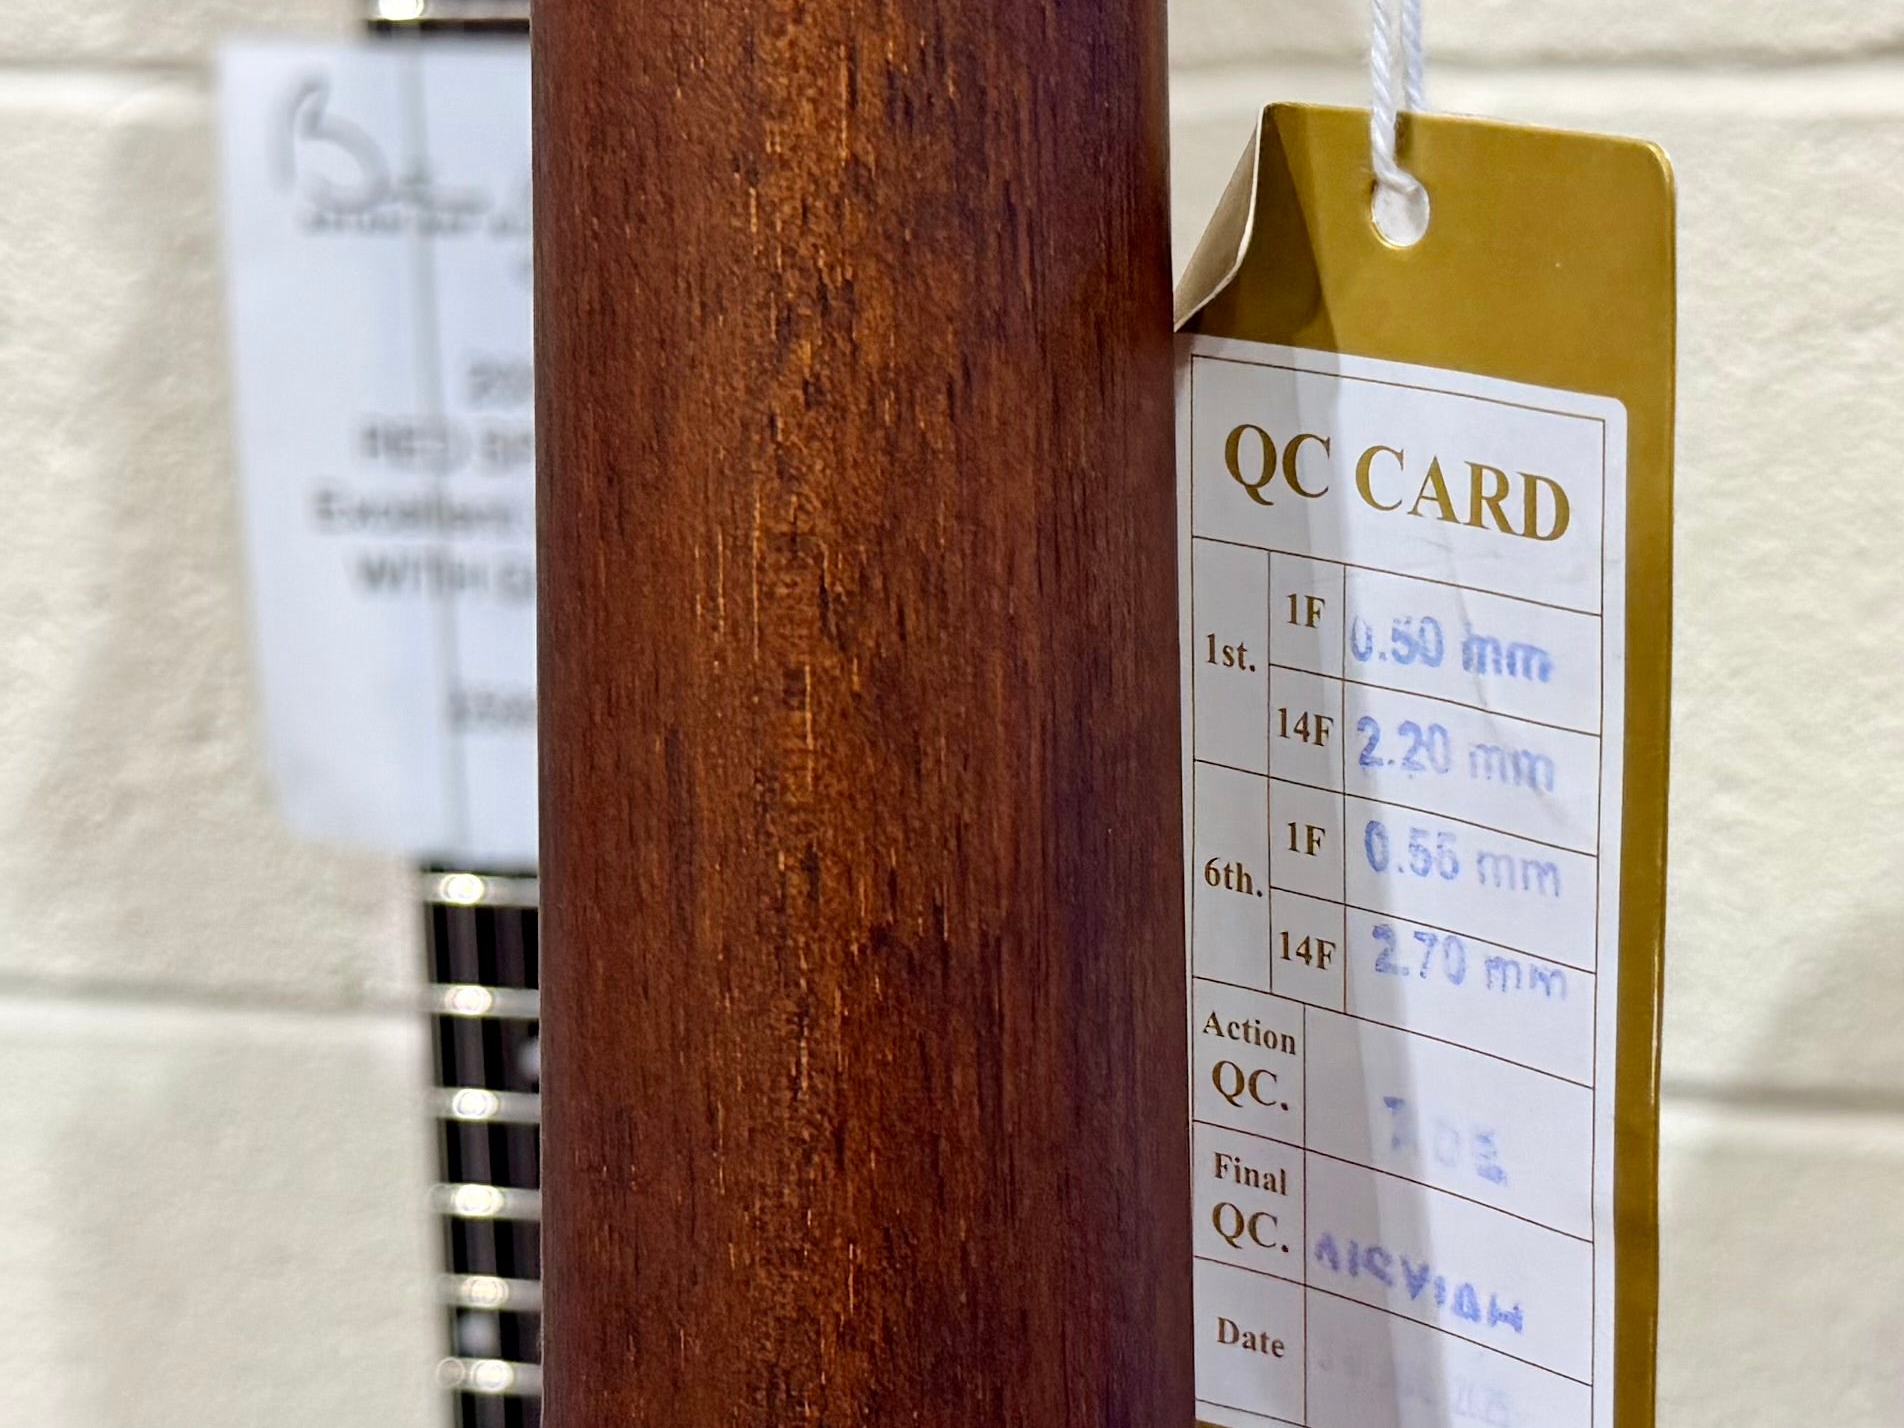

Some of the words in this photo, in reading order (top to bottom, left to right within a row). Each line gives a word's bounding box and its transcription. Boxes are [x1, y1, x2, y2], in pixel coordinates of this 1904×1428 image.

[1224, 423, 1331, 507] QC
[1354, 444, 1571, 542] CARD
[1206, 633, 1257, 673] 1st.
[1286, 592, 1326, 629] 1F
[1349, 614, 1446, 669] 0.50
[1462, 631, 1555, 684] mm
[1278, 707, 1335, 747] 14F
[1356, 715, 1452, 775] 2.20
[1468, 743, 1556, 793] mm
[1204, 856, 1264, 899] 6th.
[1287, 821, 1327, 857] 1F
[1364, 819, 1461, 881] 0.55
[1476, 849, 1562, 898] mm
[1278, 930, 1337, 972] 14F
[1371, 923, 1468, 986] 2.70
[1483, 955, 1568, 1002] mm
[1202, 1010, 1297, 1056] Action
[1211, 1059, 1290, 1112] QC.
[1213, 1151, 1289, 1197] Final
[1211, 1201, 1290, 1254] QC.
[1216, 1316, 1286, 1359] Date
